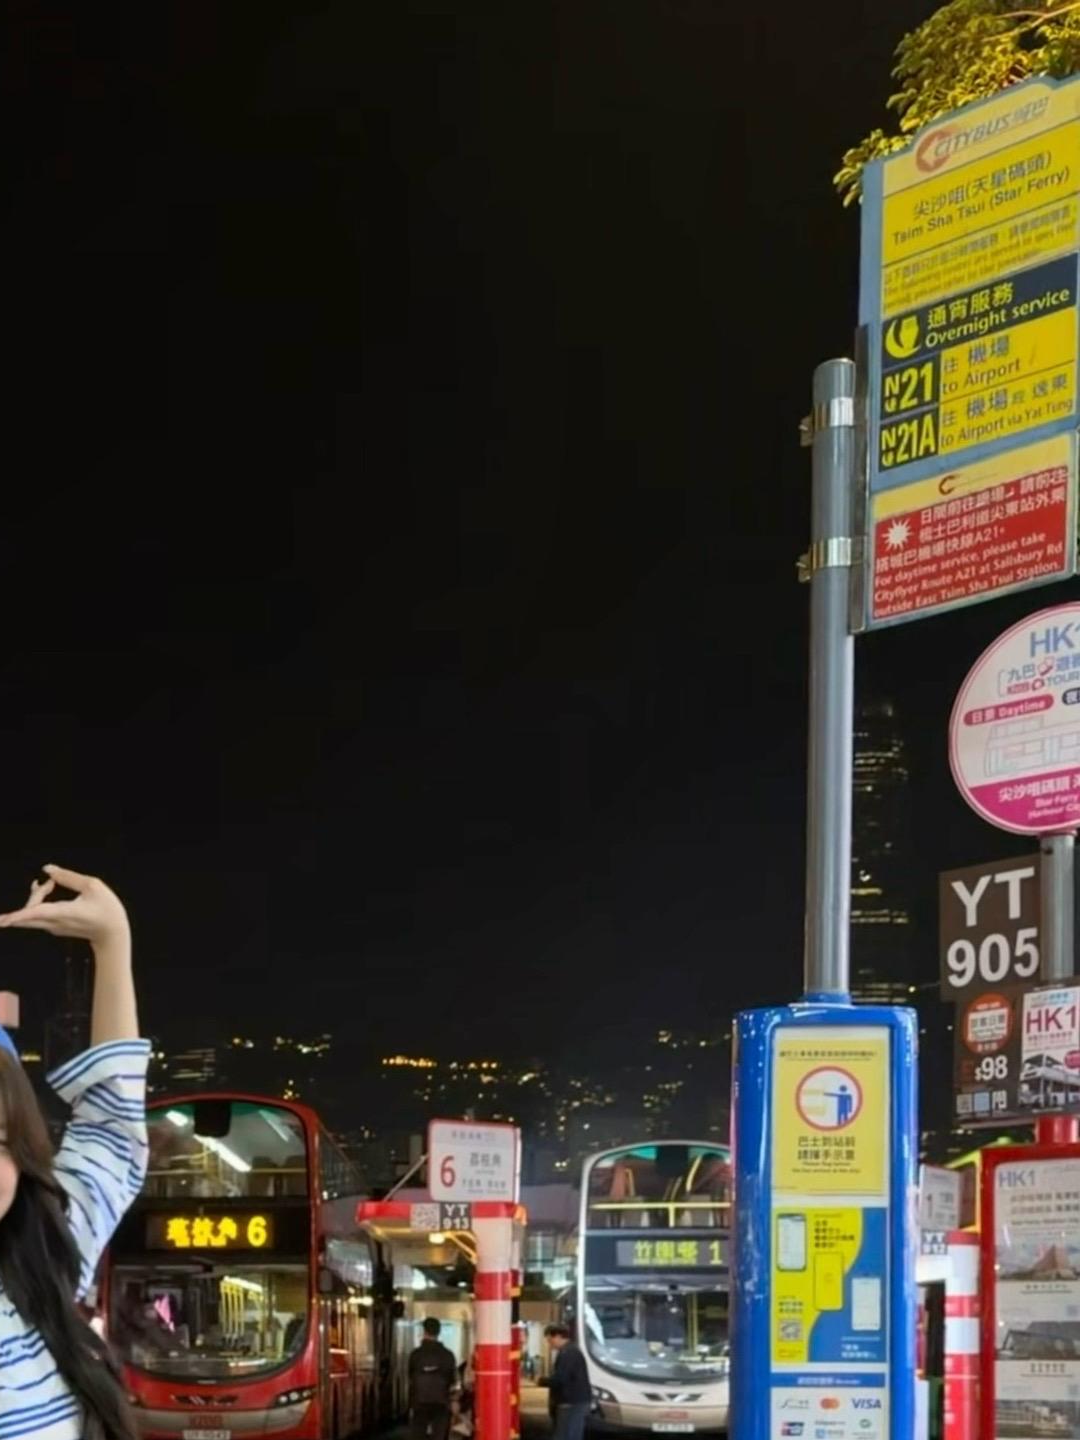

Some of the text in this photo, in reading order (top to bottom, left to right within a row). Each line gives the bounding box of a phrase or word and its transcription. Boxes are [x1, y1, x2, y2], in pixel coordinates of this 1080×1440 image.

[935, 112, 1010, 157] CITYBUS
[893, 166, 1071, 246] Tsim Sha Tsui (Star Ferry)
[925, 287, 1070, 347] Overnight service
[928, 282, 1014, 329] 通宵服務
[942, 358, 1021, 395] to Airport
[940, 398, 1073, 447] to Airport via Yat Tung
[874, 541, 1063, 602] Cityflyer Route A21 at Salisbury Rd
[875, 532, 1046, 587] For daytime service, please take
[874, 601, 912, 617] outside
[940, 584, 966, 600] Tsim
[969, 578, 989, 592] Sha
[991, 571, 1014, 586] Tsui
[1016, 560, 1061, 580] Station.
[998, 699, 1047, 720] Daytime
[951, 866, 1036, 927] YT
[946, 926, 1040, 988] 905
[1026, 1005, 1077, 1034] HK1
[974, 1055, 1008, 1081] $98
[440, 1155, 456, 1188] 6
[999, 1169, 1036, 1188] HK1
[444, 1203, 469, 1217] YT
[247, 1215, 267, 1248] 6
[708, 1239, 723, 1266] 1
[851, 1398, 882, 1410] VISA
